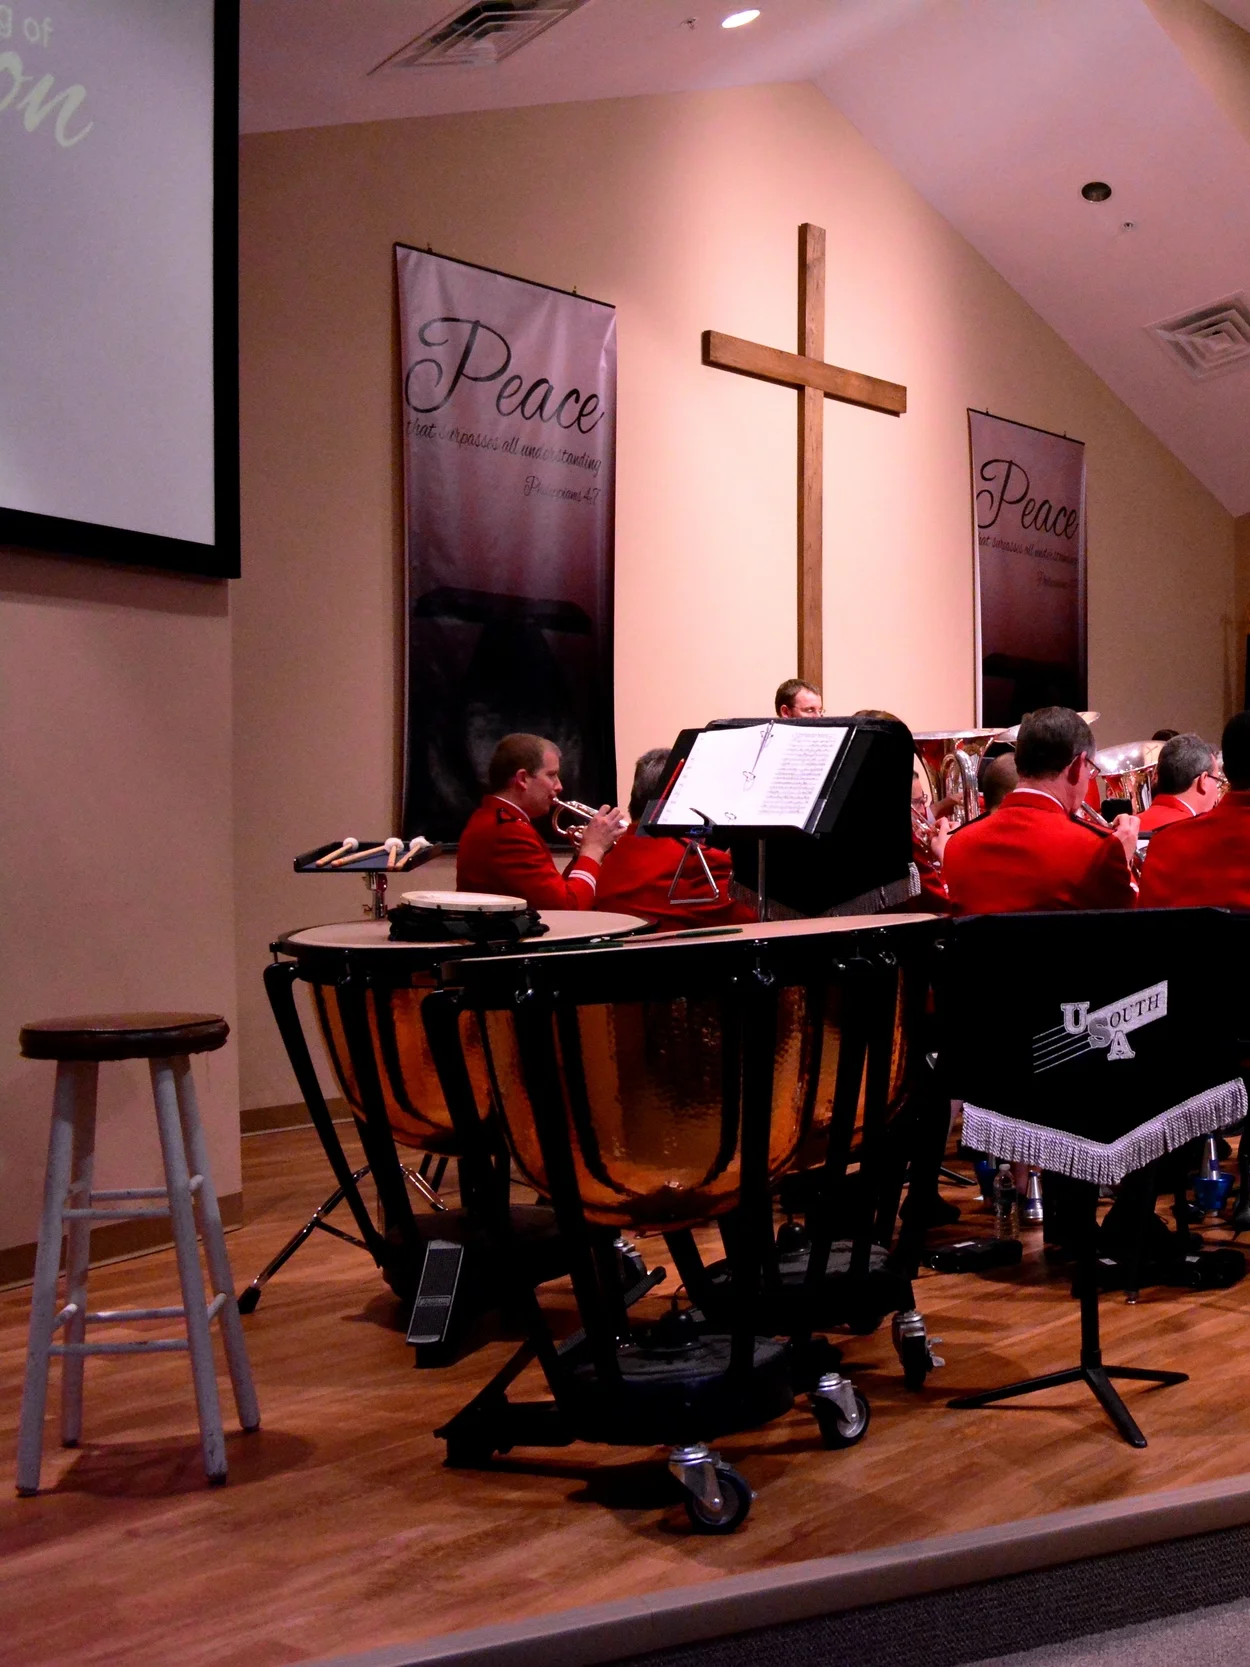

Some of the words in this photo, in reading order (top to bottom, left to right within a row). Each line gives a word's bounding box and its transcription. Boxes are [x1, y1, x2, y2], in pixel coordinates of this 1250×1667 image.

[24, 17, 54, 48] of
[405, 317, 605, 434] Peace
[405, 418, 437, 439] that
[501, 436, 520, 455] all
[976, 458, 1080, 540] Peace
